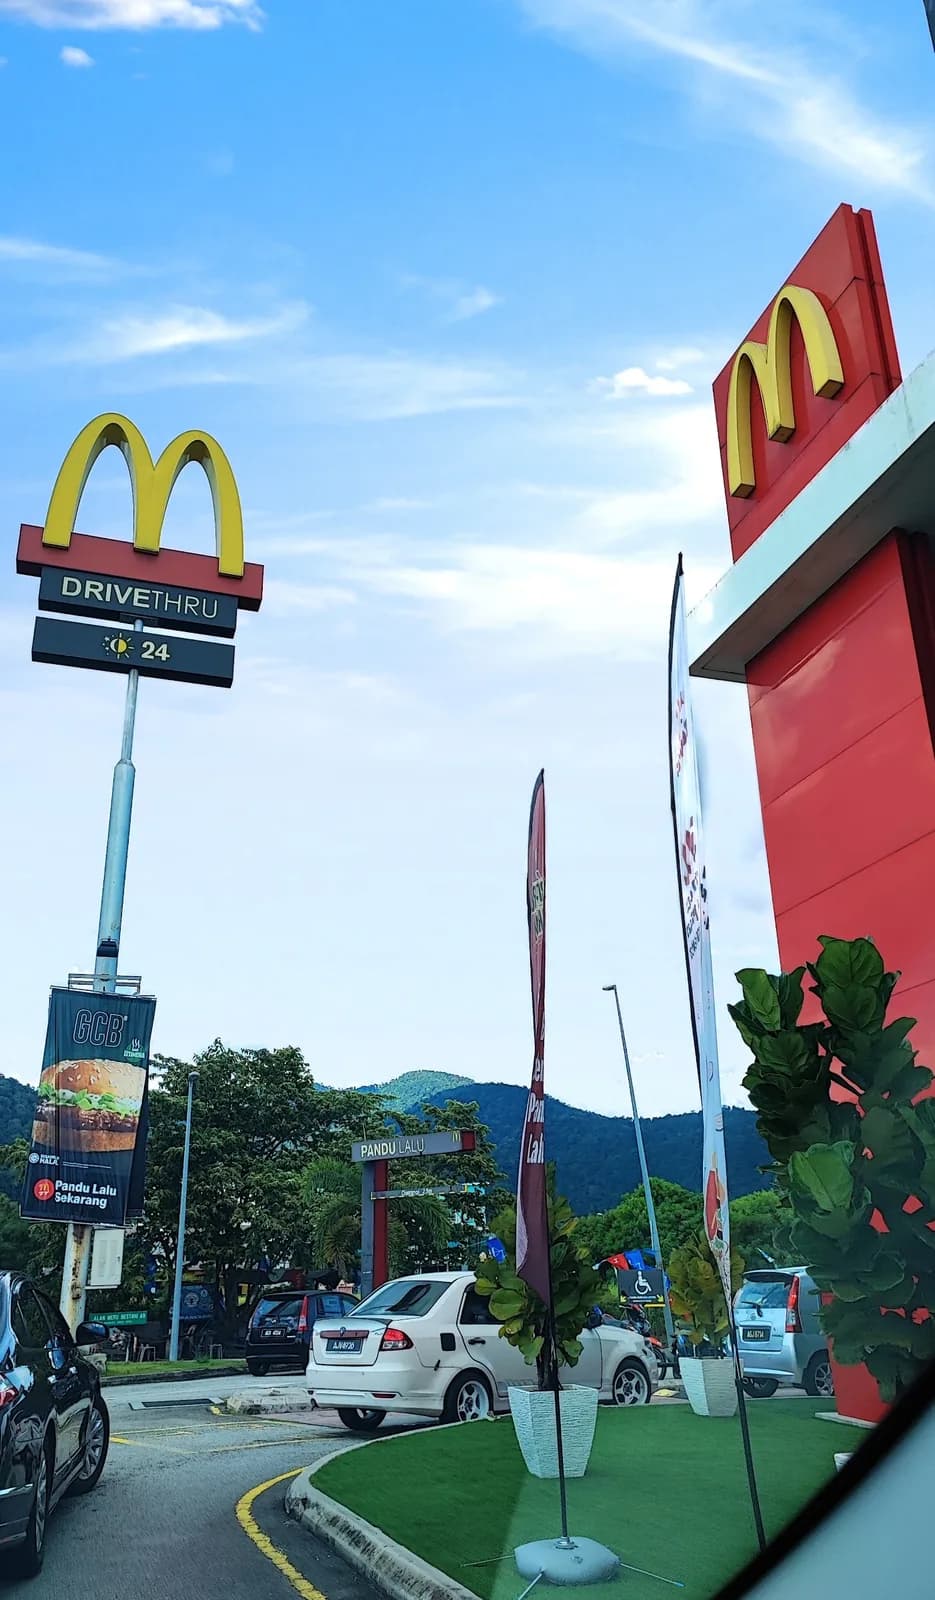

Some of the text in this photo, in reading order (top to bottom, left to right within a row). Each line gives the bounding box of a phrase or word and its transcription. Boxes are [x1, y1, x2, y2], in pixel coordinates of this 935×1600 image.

[61, 576, 218, 618] DRIVETHRU
[141, 641, 170, 661] 24
[73, 1008, 124, 1048] GCB
[361, 1138, 424, 1158] PANDU LALU
[55, 1180, 117, 1196] Pandu Lalu
[55, 1192, 108, 1210] Sekarang
